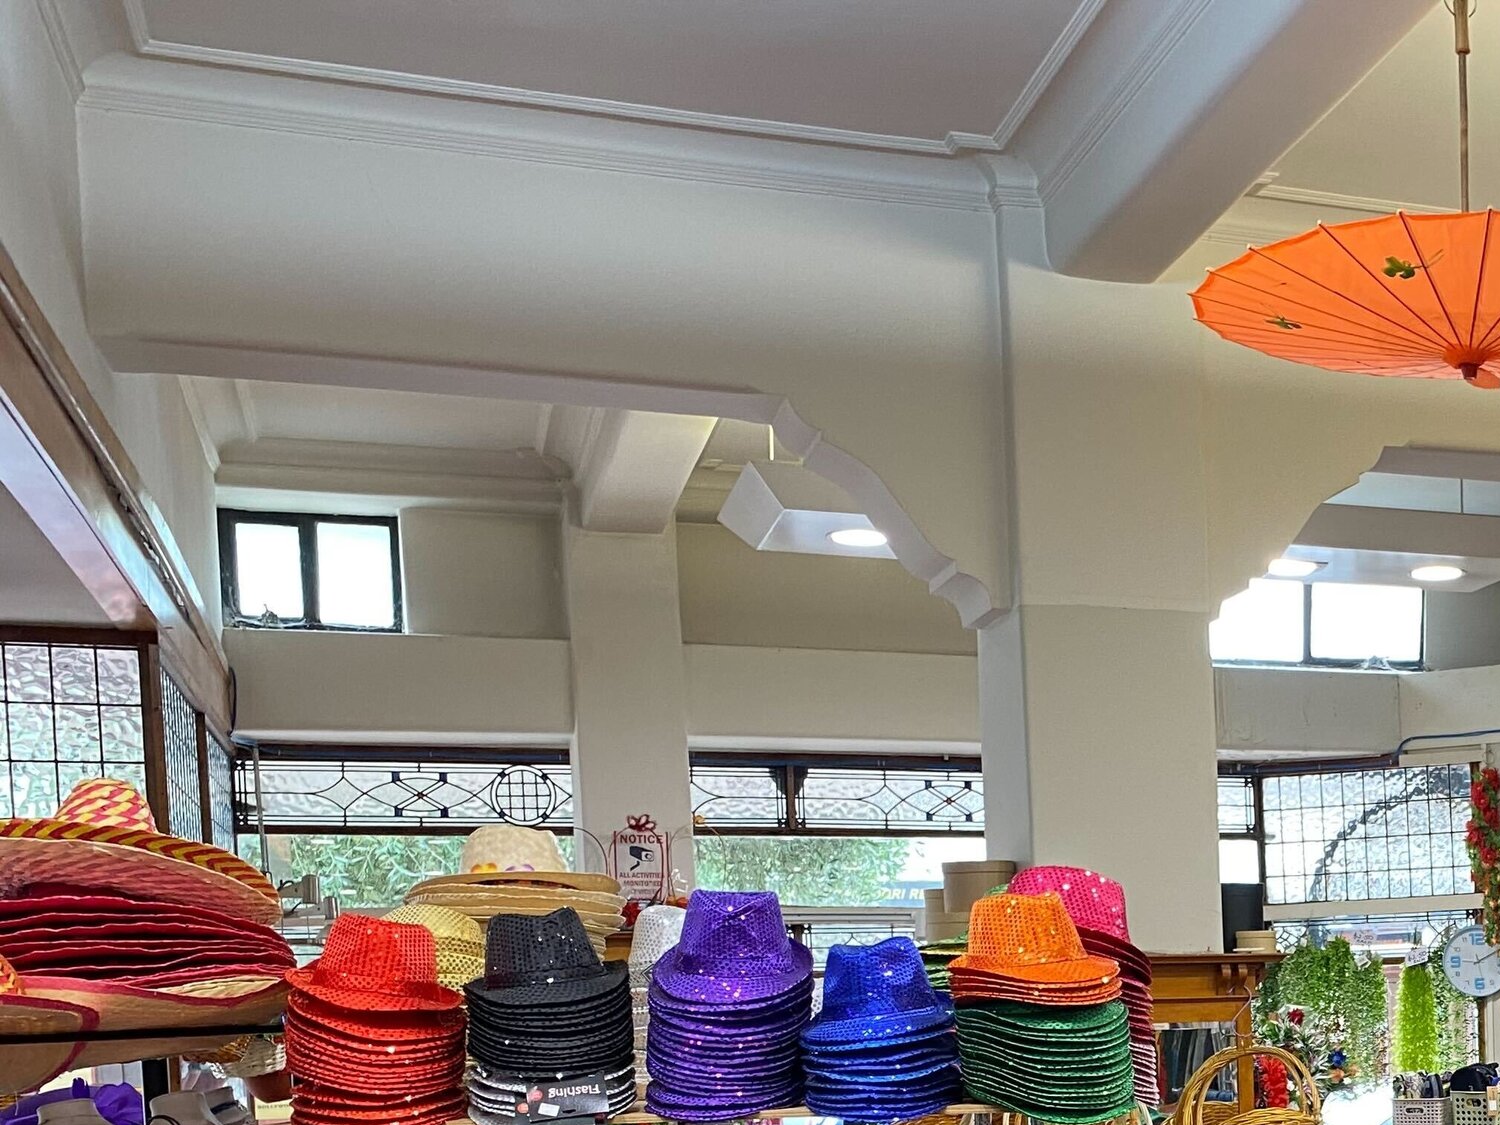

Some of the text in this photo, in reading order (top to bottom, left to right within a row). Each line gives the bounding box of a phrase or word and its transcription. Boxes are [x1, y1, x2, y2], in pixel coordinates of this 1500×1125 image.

[620, 834, 664, 844] NOTICE
[1469, 933, 1485, 945] 12
[1451, 956, 1460, 968] 9
[1475, 977, 1485, 990] 6
[547, 1084, 602, 1098] Flashing
